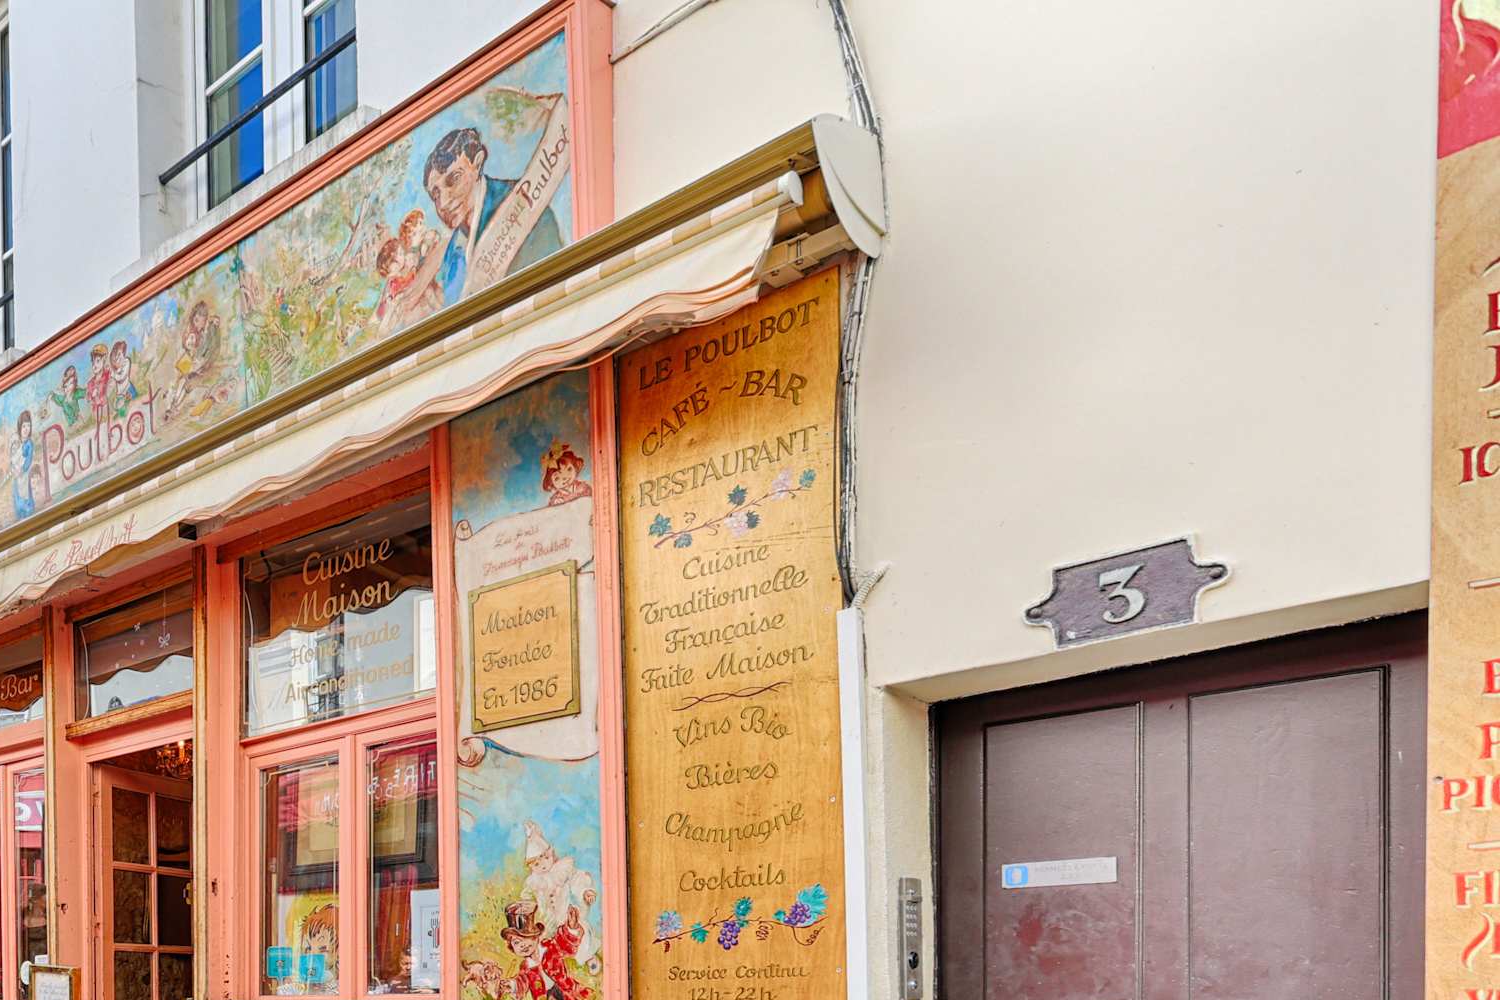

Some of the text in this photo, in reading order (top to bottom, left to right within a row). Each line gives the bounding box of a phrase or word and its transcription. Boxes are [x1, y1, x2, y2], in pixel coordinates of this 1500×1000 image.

[517, 124, 570, 209] Poulbot
[639, 296, 820, 391] LE POULBOT
[641, 368, 808, 457] CAFÉ BAR
[41, 380, 162, 503] Poulbot
[639, 424, 818, 507] RESTAURANT
[302, 538, 394, 586] Cuisine
[682, 545, 771, 581] Cuisine
[291, 580, 399, 628] Maison
[639, 565, 809, 625] Traditionnelle
[1098, 562, 1146, 625] 3
[481, 605, 557, 636] Maison
[665, 612, 786, 654] Française
[483, 641, 553, 673] Fondée
[641, 644, 814, 693] Faite Maison
[1, 673, 38, 701] Bar
[483, 675, 559, 710] En 1986
[672, 706, 792, 748] Vins Bio
[685, 761, 779, 790] Bières
[665, 801, 805, 852] Champagne
[679, 863, 787, 892] Cocktails
[668, 963, 810, 981] Service Continu
